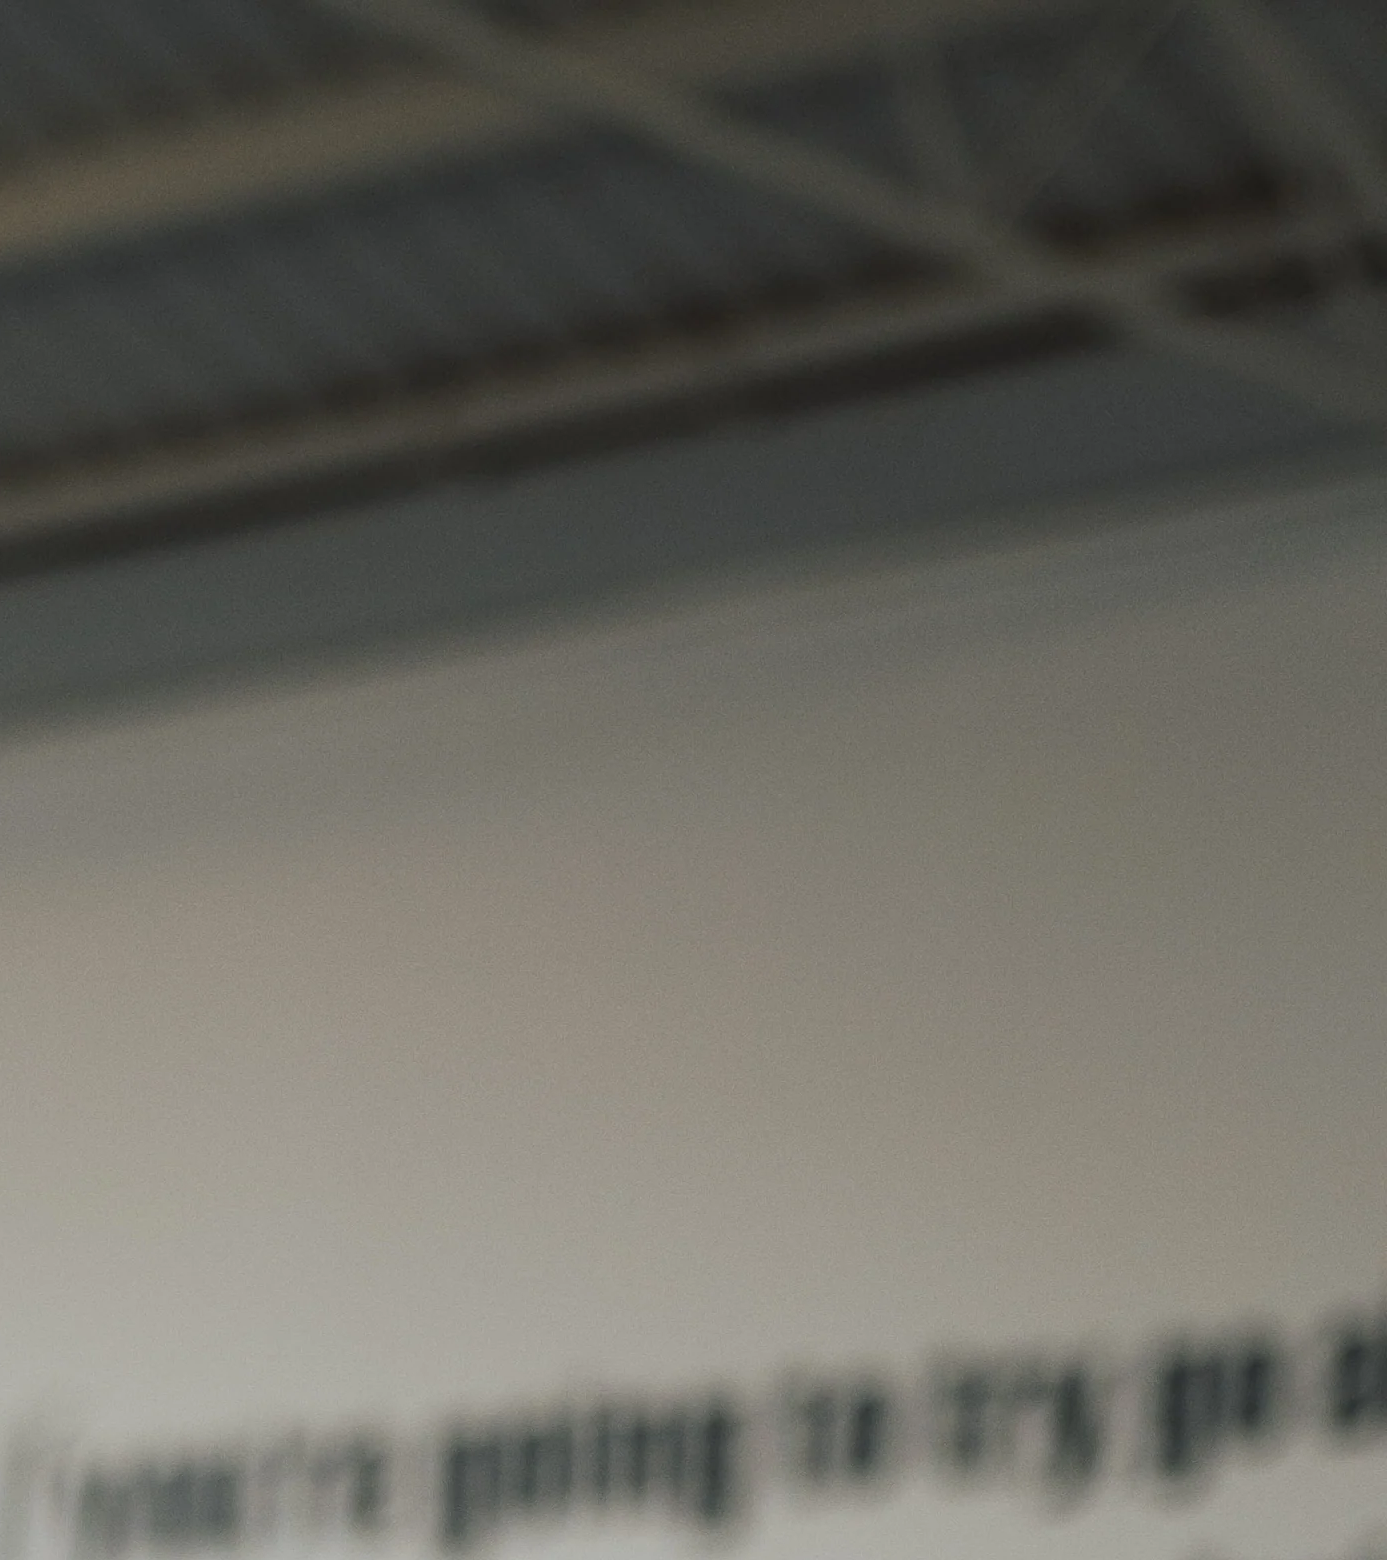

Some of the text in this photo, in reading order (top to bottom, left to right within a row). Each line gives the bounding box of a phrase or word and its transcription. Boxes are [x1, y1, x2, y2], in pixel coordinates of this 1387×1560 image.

[439, 1390, 739, 1560] going
[930, 1340, 1107, 1512] try
[1159, 1325, 1282, 1490] go
